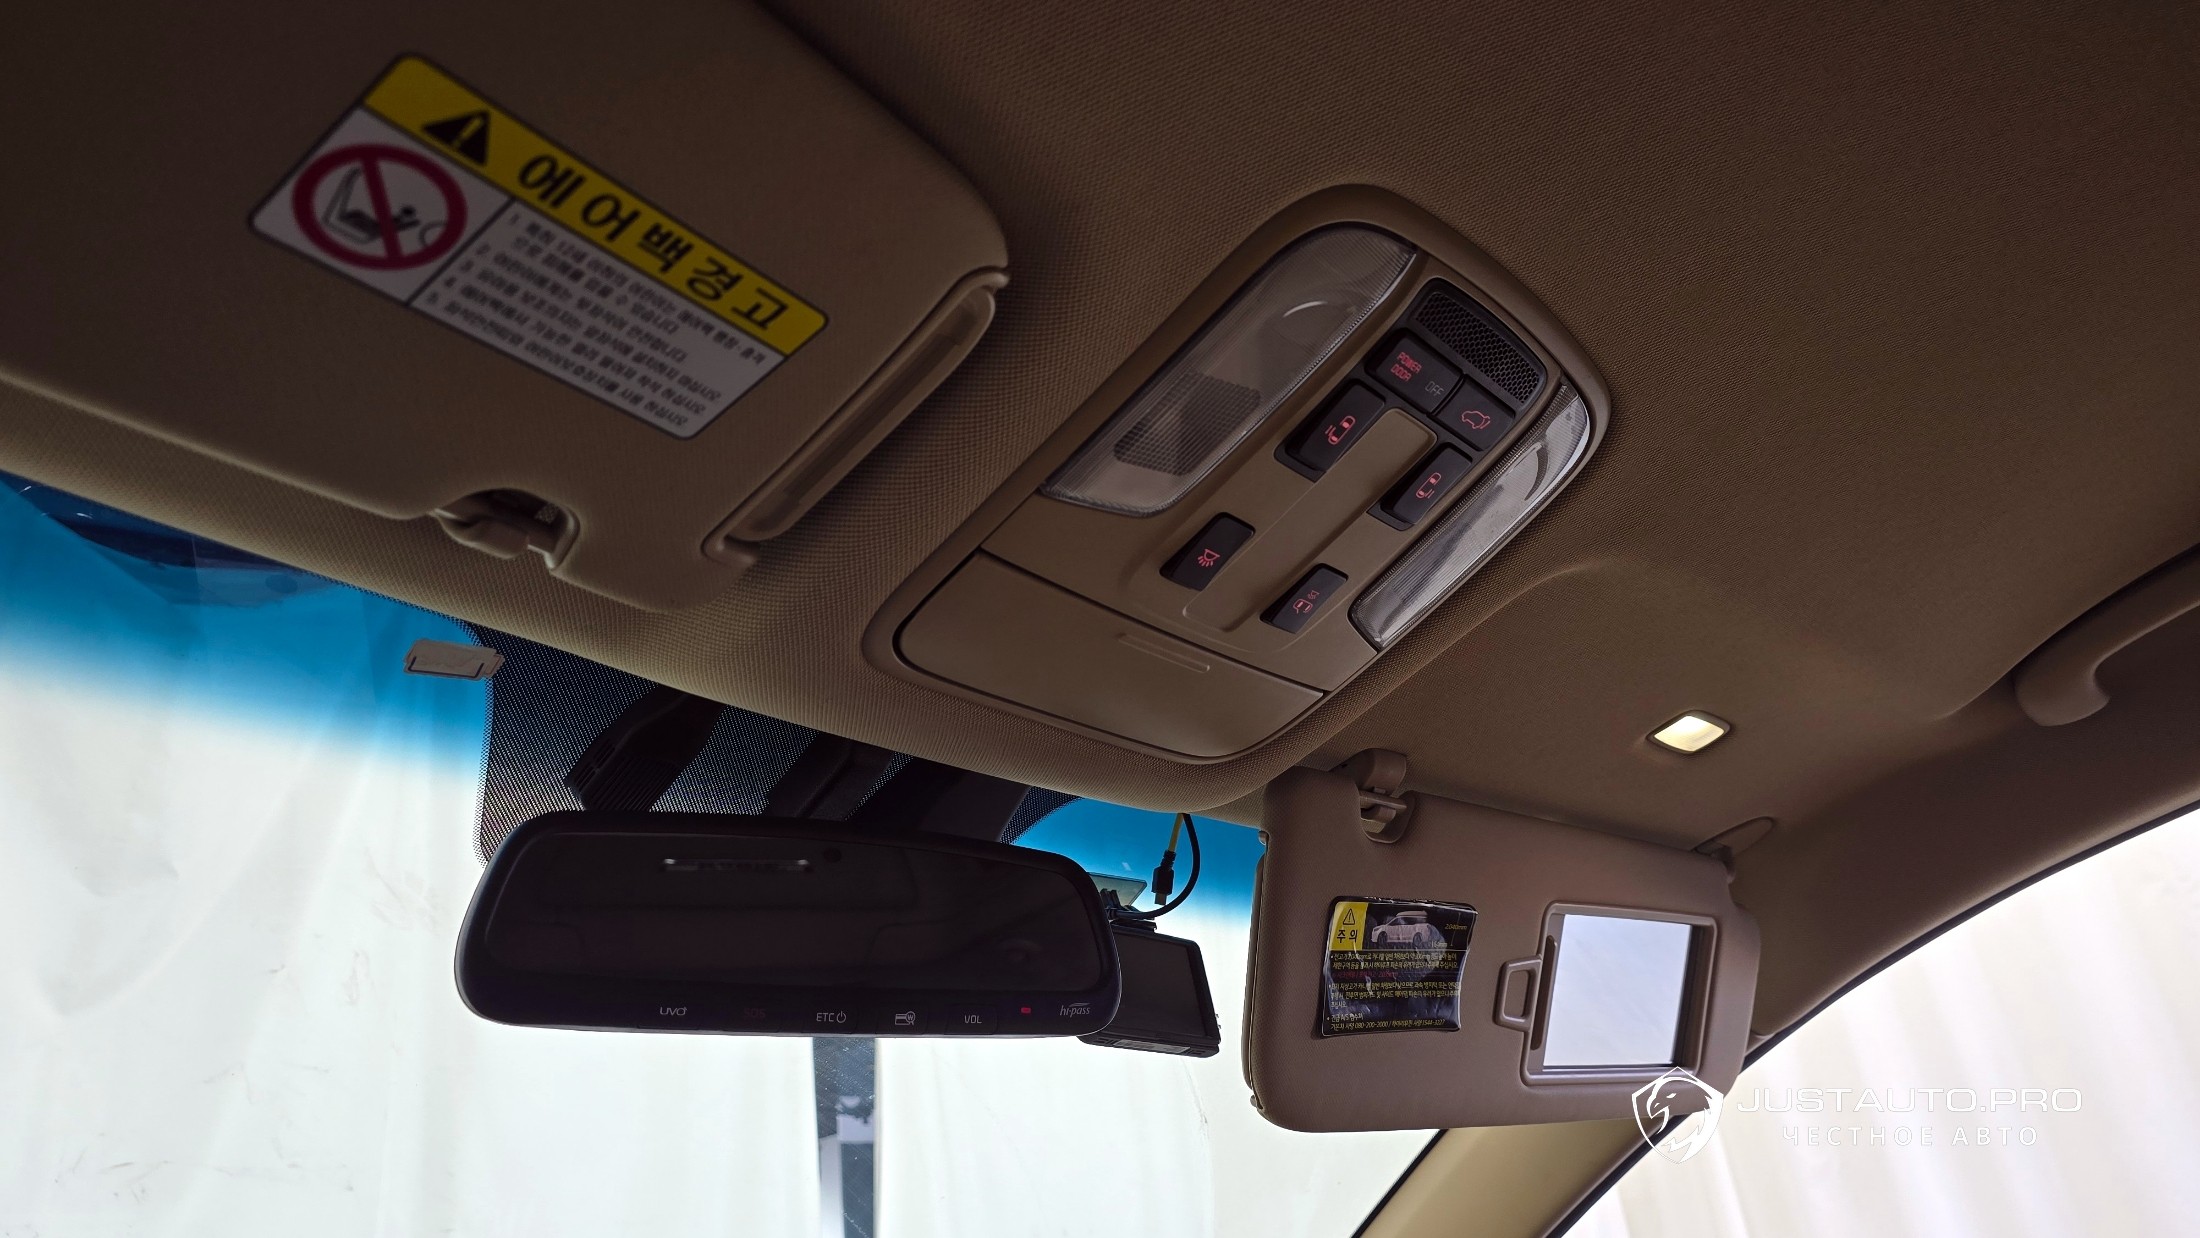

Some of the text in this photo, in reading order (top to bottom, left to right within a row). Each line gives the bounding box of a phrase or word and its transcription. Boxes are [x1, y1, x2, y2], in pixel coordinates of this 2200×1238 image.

[1397, 352, 1421, 373] POWER
[1391, 364, 1411, 381] DOOR
[1425, 381, 1444, 396] OFF
[816, 1012, 834, 1022] ETC
[964, 1015, 982, 1024] VOL
